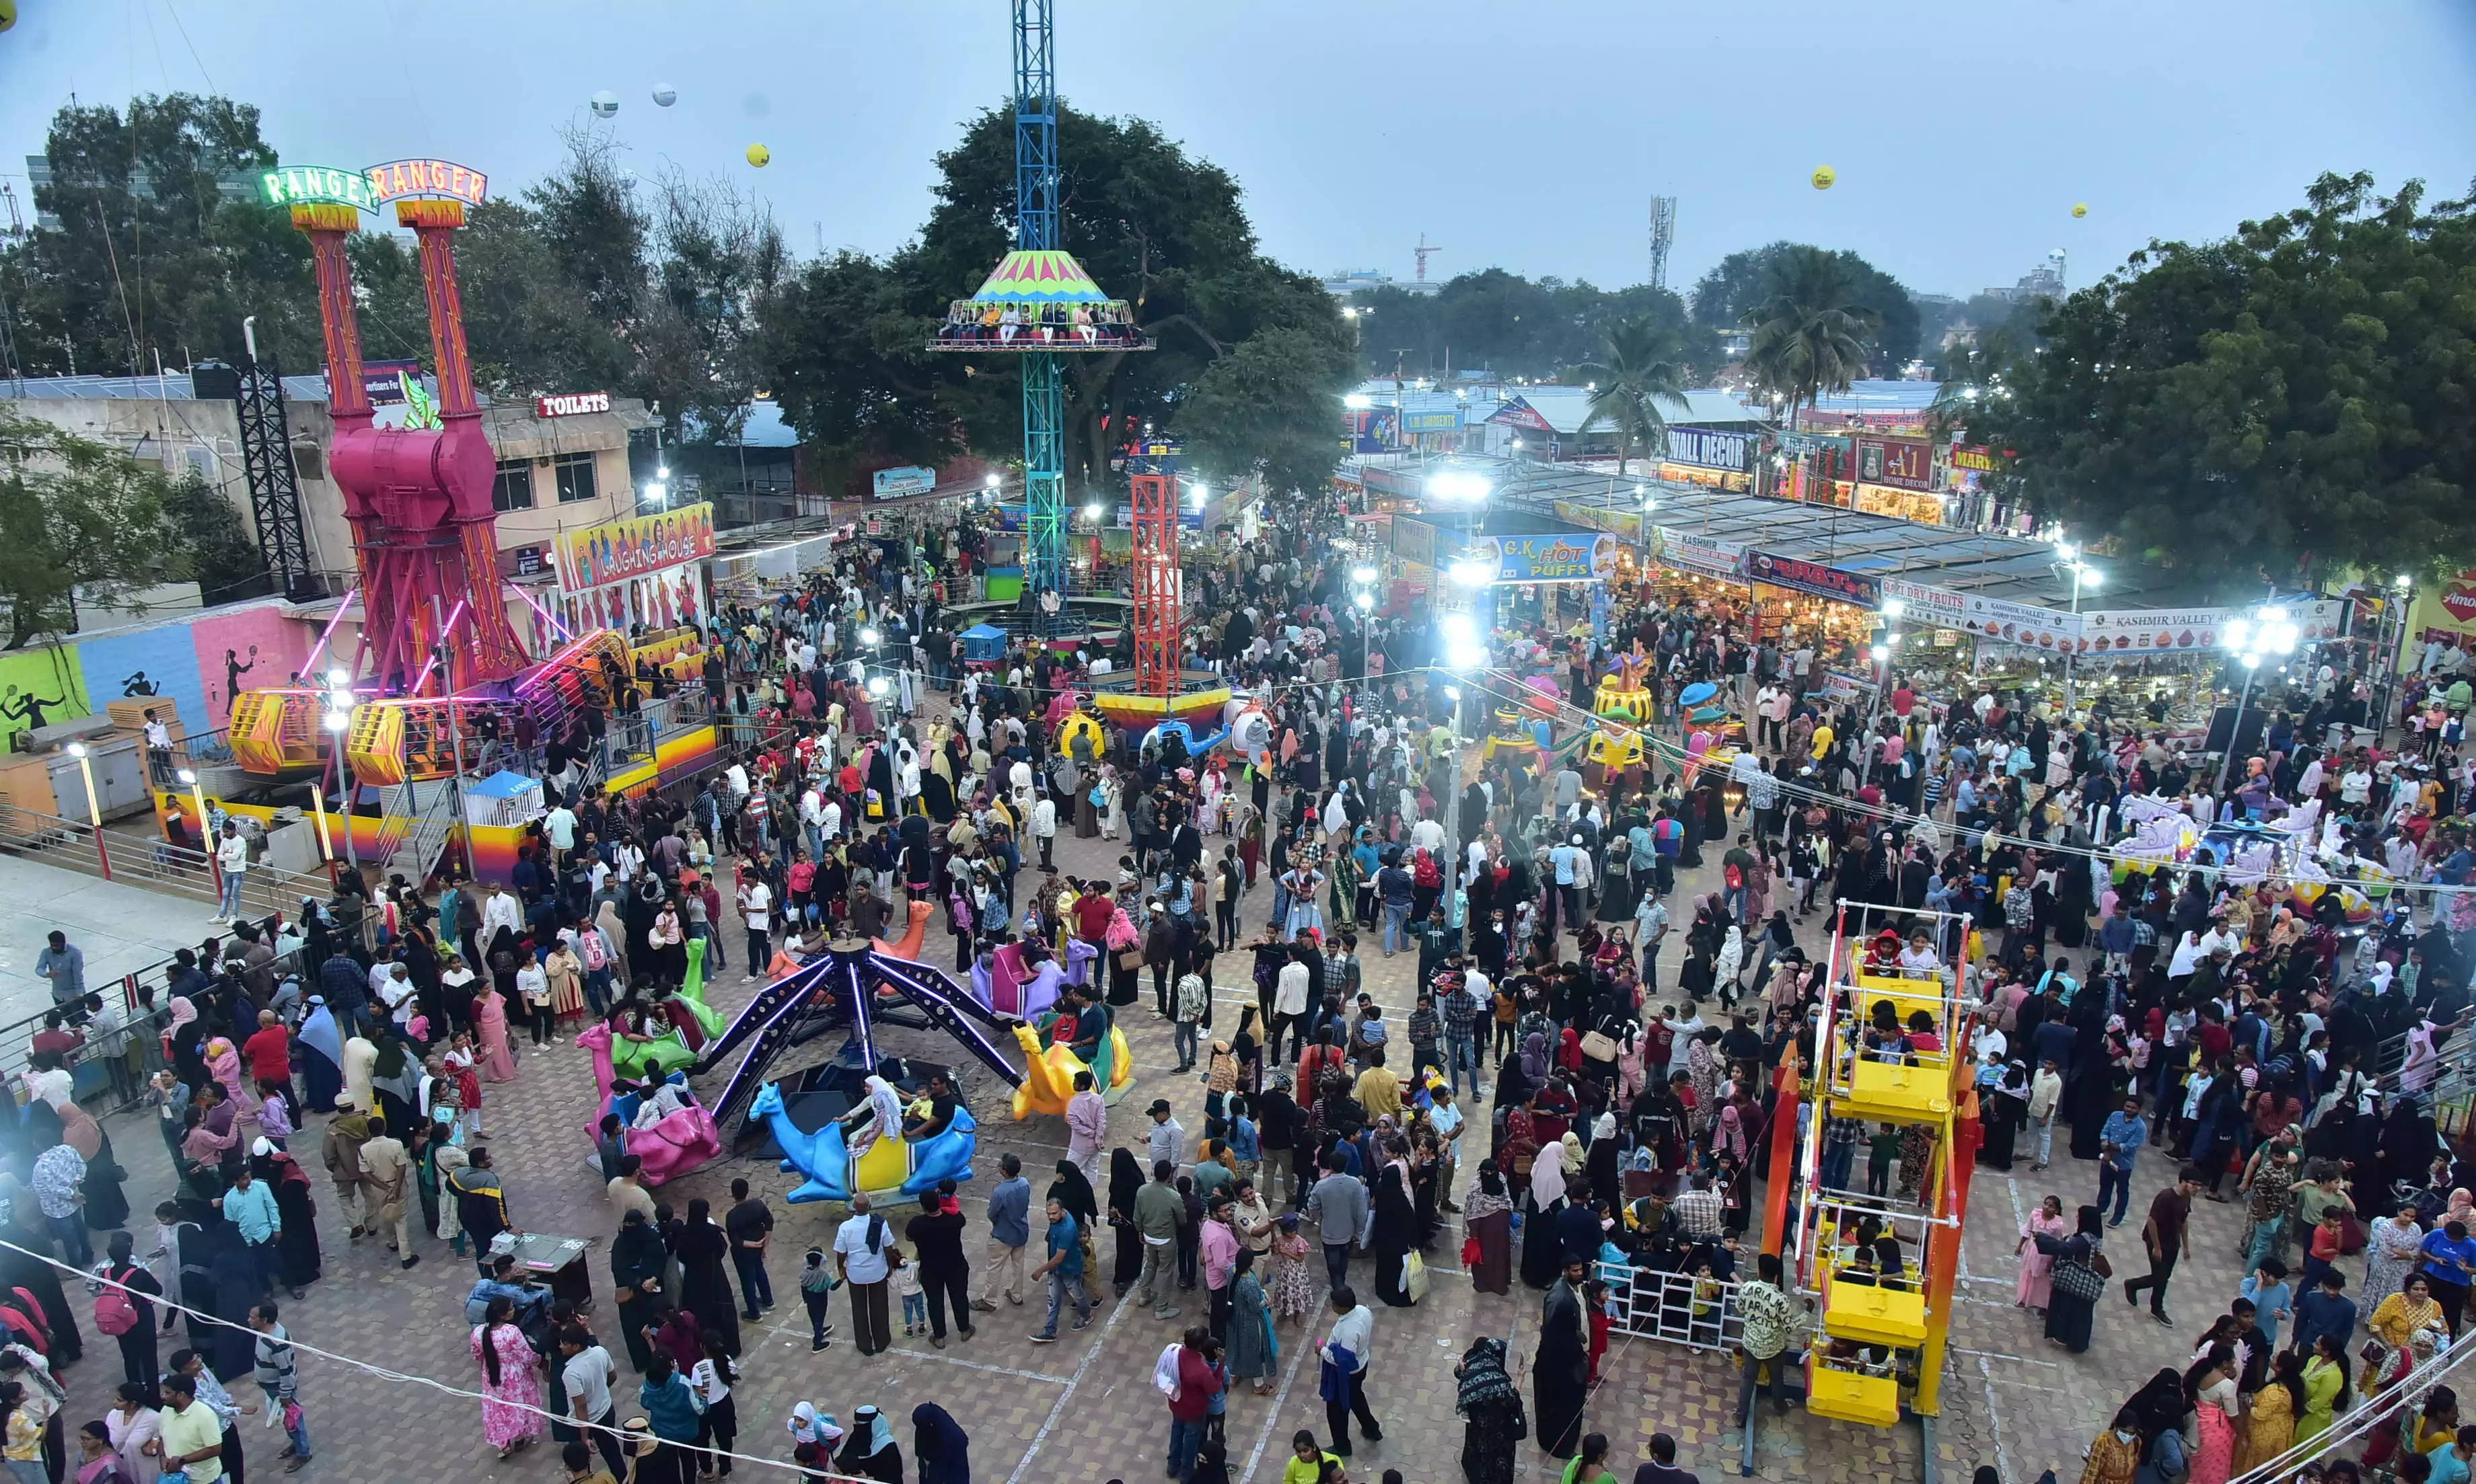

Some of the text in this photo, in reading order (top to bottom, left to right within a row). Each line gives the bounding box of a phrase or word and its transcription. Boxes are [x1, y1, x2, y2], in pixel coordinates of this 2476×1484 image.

[371, 161, 486, 204] RANGER
[543, 394, 610, 416] TOILETS
[1668, 429, 1745, 468] WALL DECOR
[1884, 476, 1929, 489] HOME DECOR
[1682, 534, 1718, 551] KASHMIR
[600, 536, 696, 577] LAUGHING HOUSE
[1539, 546, 1588, 564] HOT
[1531, 564, 1587, 577] PUFFS
[1883, 581, 1904, 595] QAZI
[1907, 585, 1926, 600] DRY
[1928, 591, 1964, 607] FRUITS
[2442, 592, 2476, 608] Amo
[1934, 601, 1963, 614] FRUITS
[1990, 601, 2046, 619] KASHMIR VALLEY
[2010, 613, 2043, 627] INDUSTRY
[2115, 615, 2169, 627] KASHMIR
[2172, 614, 2215, 625] VALLEY
[2216, 611, 2247, 623] AGRO
